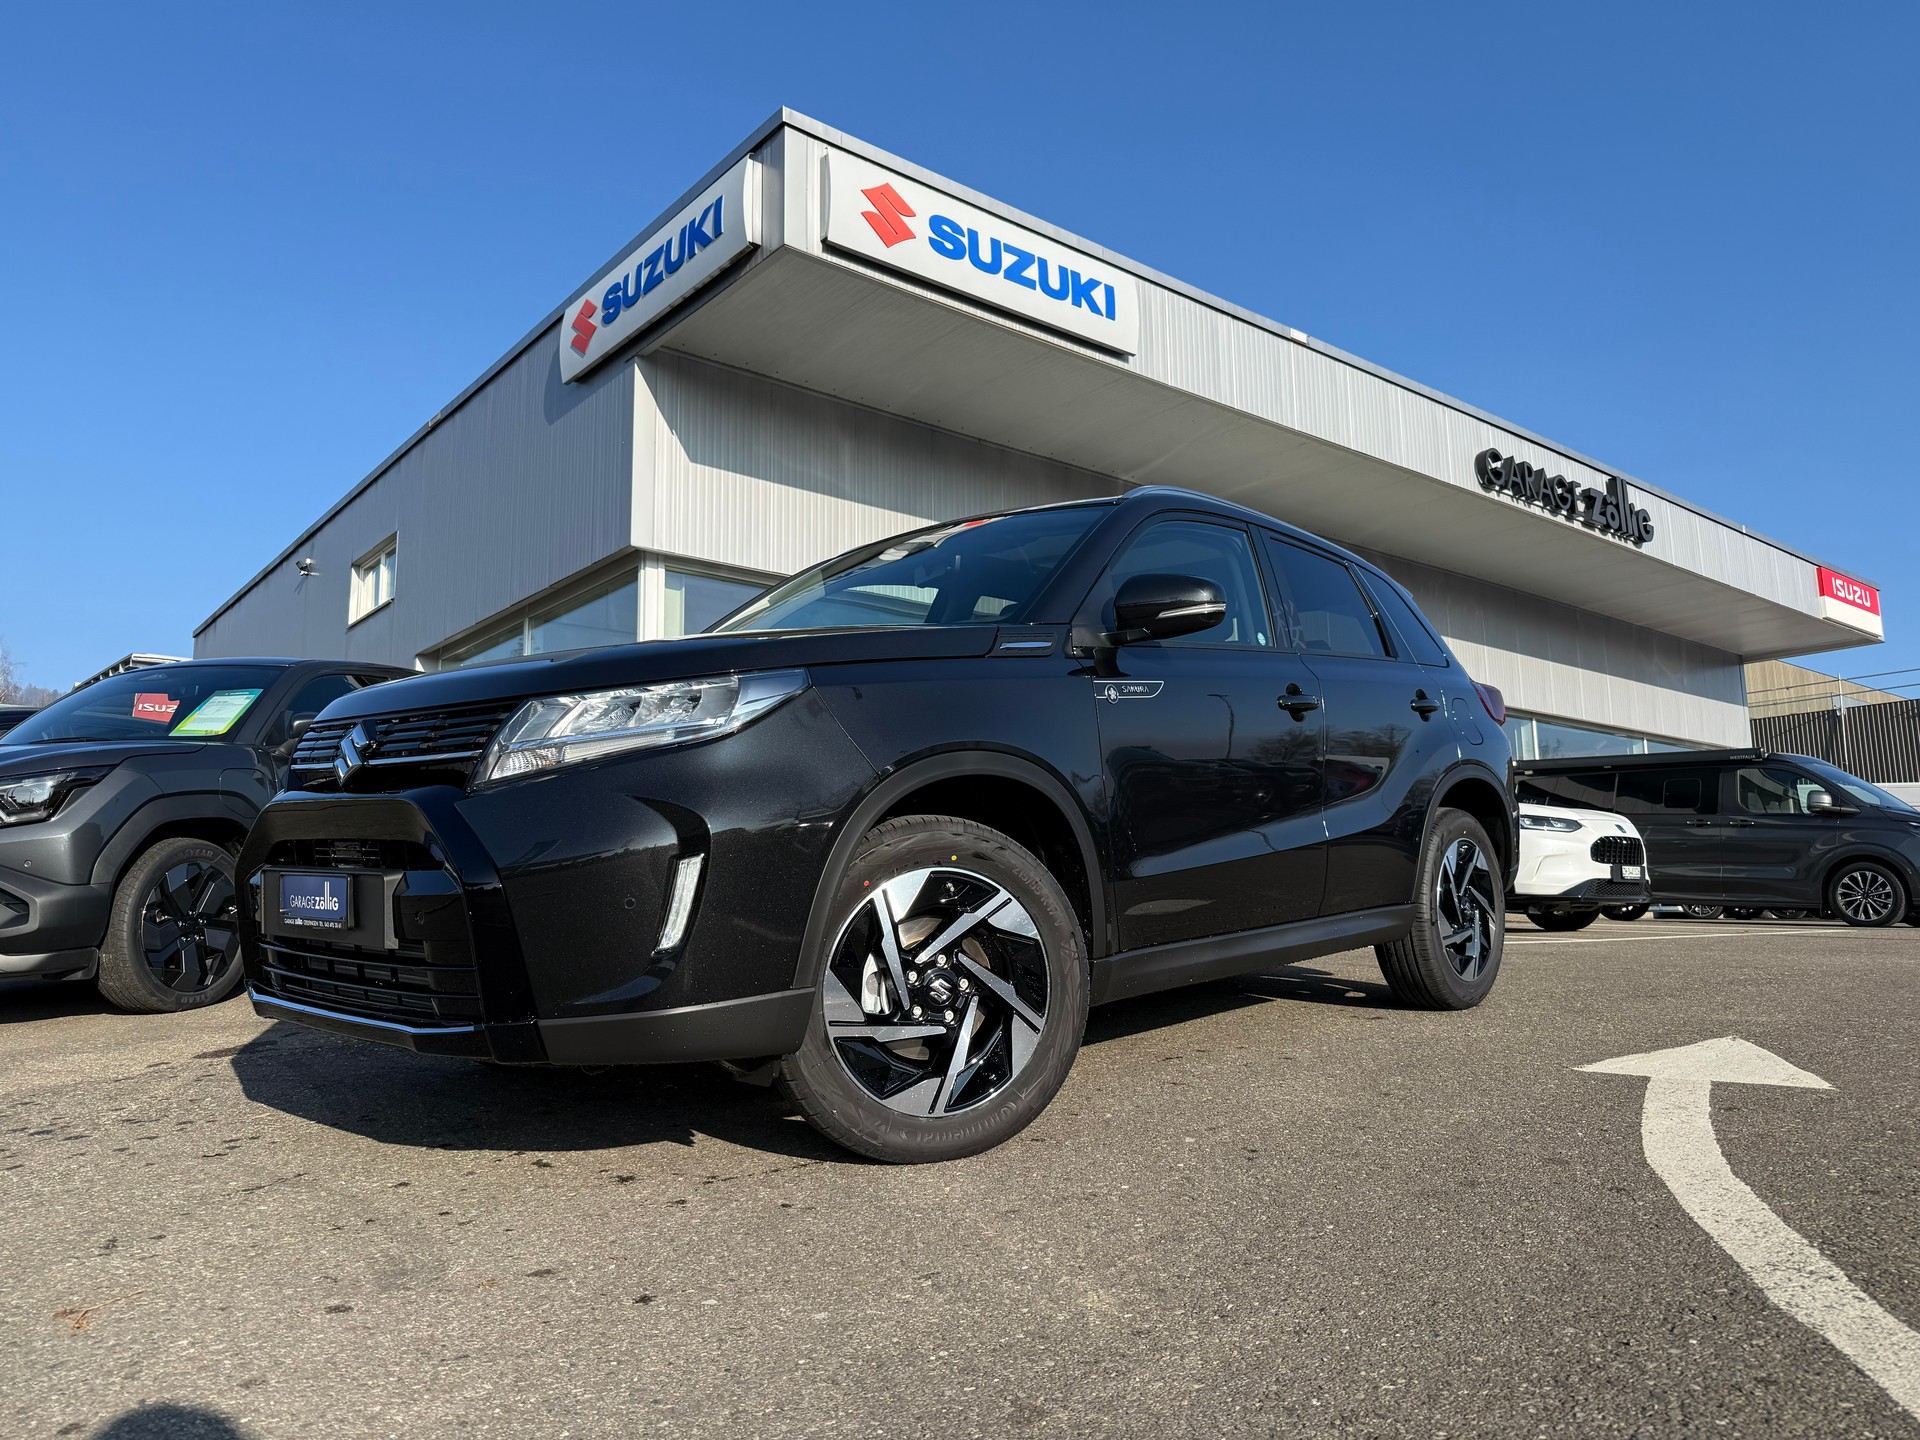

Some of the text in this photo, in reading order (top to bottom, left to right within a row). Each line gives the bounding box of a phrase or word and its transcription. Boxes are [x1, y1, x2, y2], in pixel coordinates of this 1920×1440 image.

[601, 194, 724, 325] SUZUKI
[928, 214, 1116, 321] SUZUKI
[1831, 576, 1871, 608] ISUZU
[1121, 685, 1149, 693] SAKURA
[137, 703, 178, 713] ISUZ
